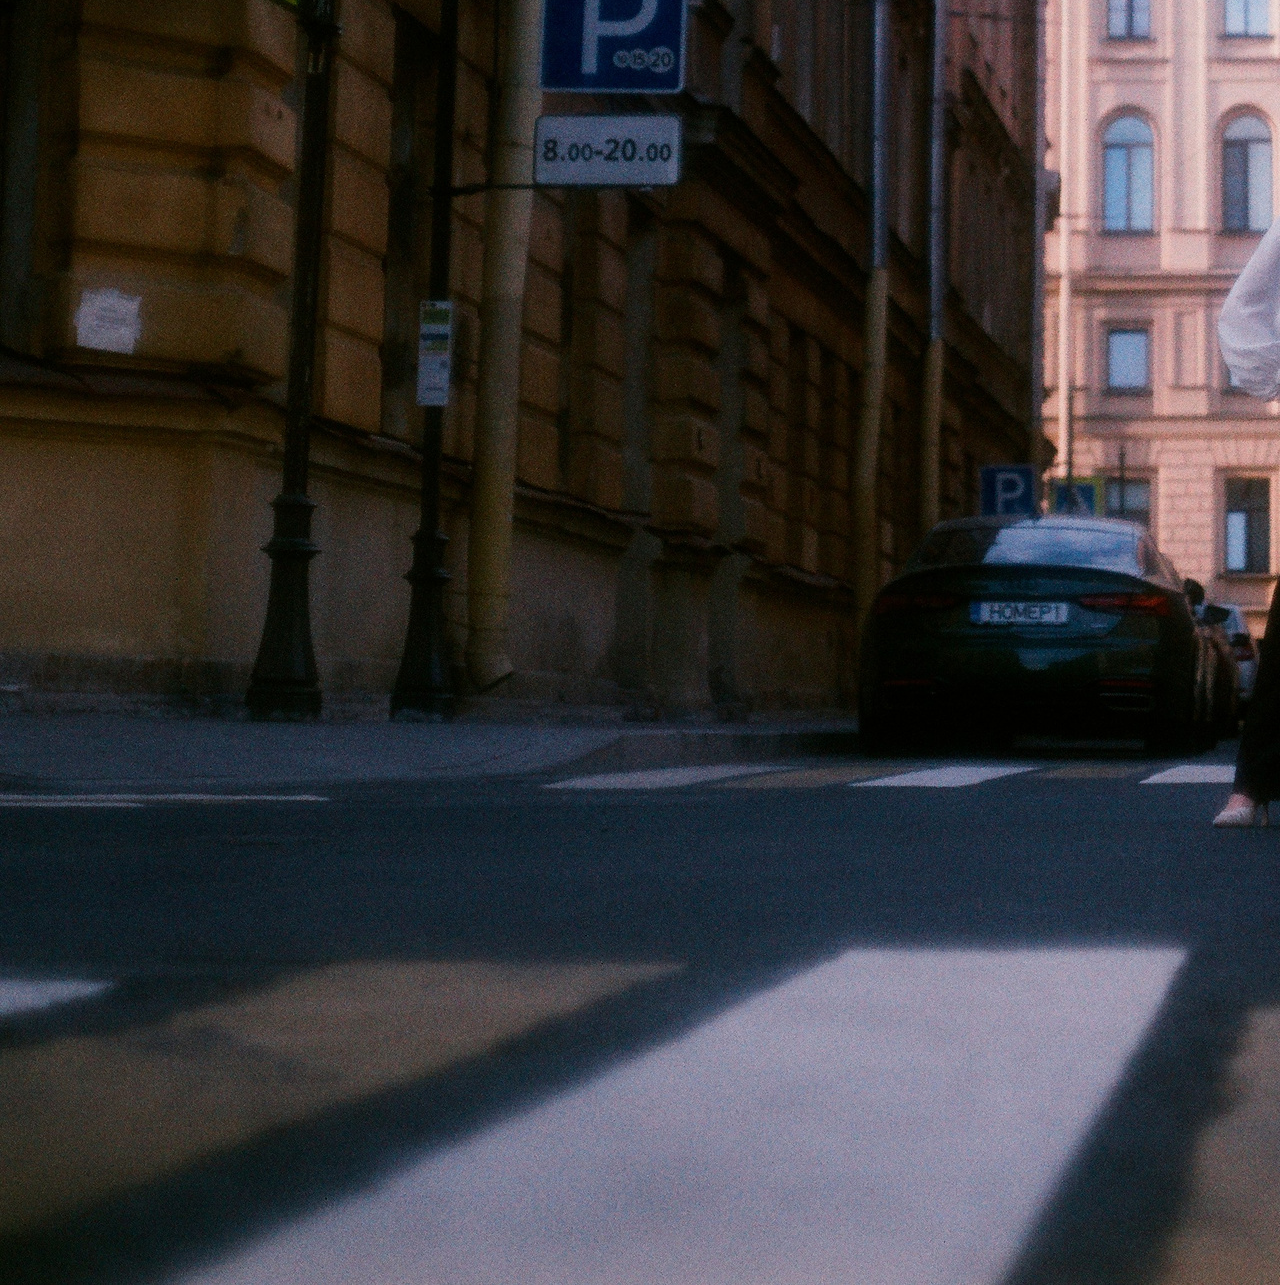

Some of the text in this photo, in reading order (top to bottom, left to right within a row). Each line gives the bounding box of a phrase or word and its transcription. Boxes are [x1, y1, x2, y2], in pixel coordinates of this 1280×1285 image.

[651, 51, 672, 68] 20
[543, 138, 672, 162] 8.00-20.00
[996, 473, 1025, 515] P
